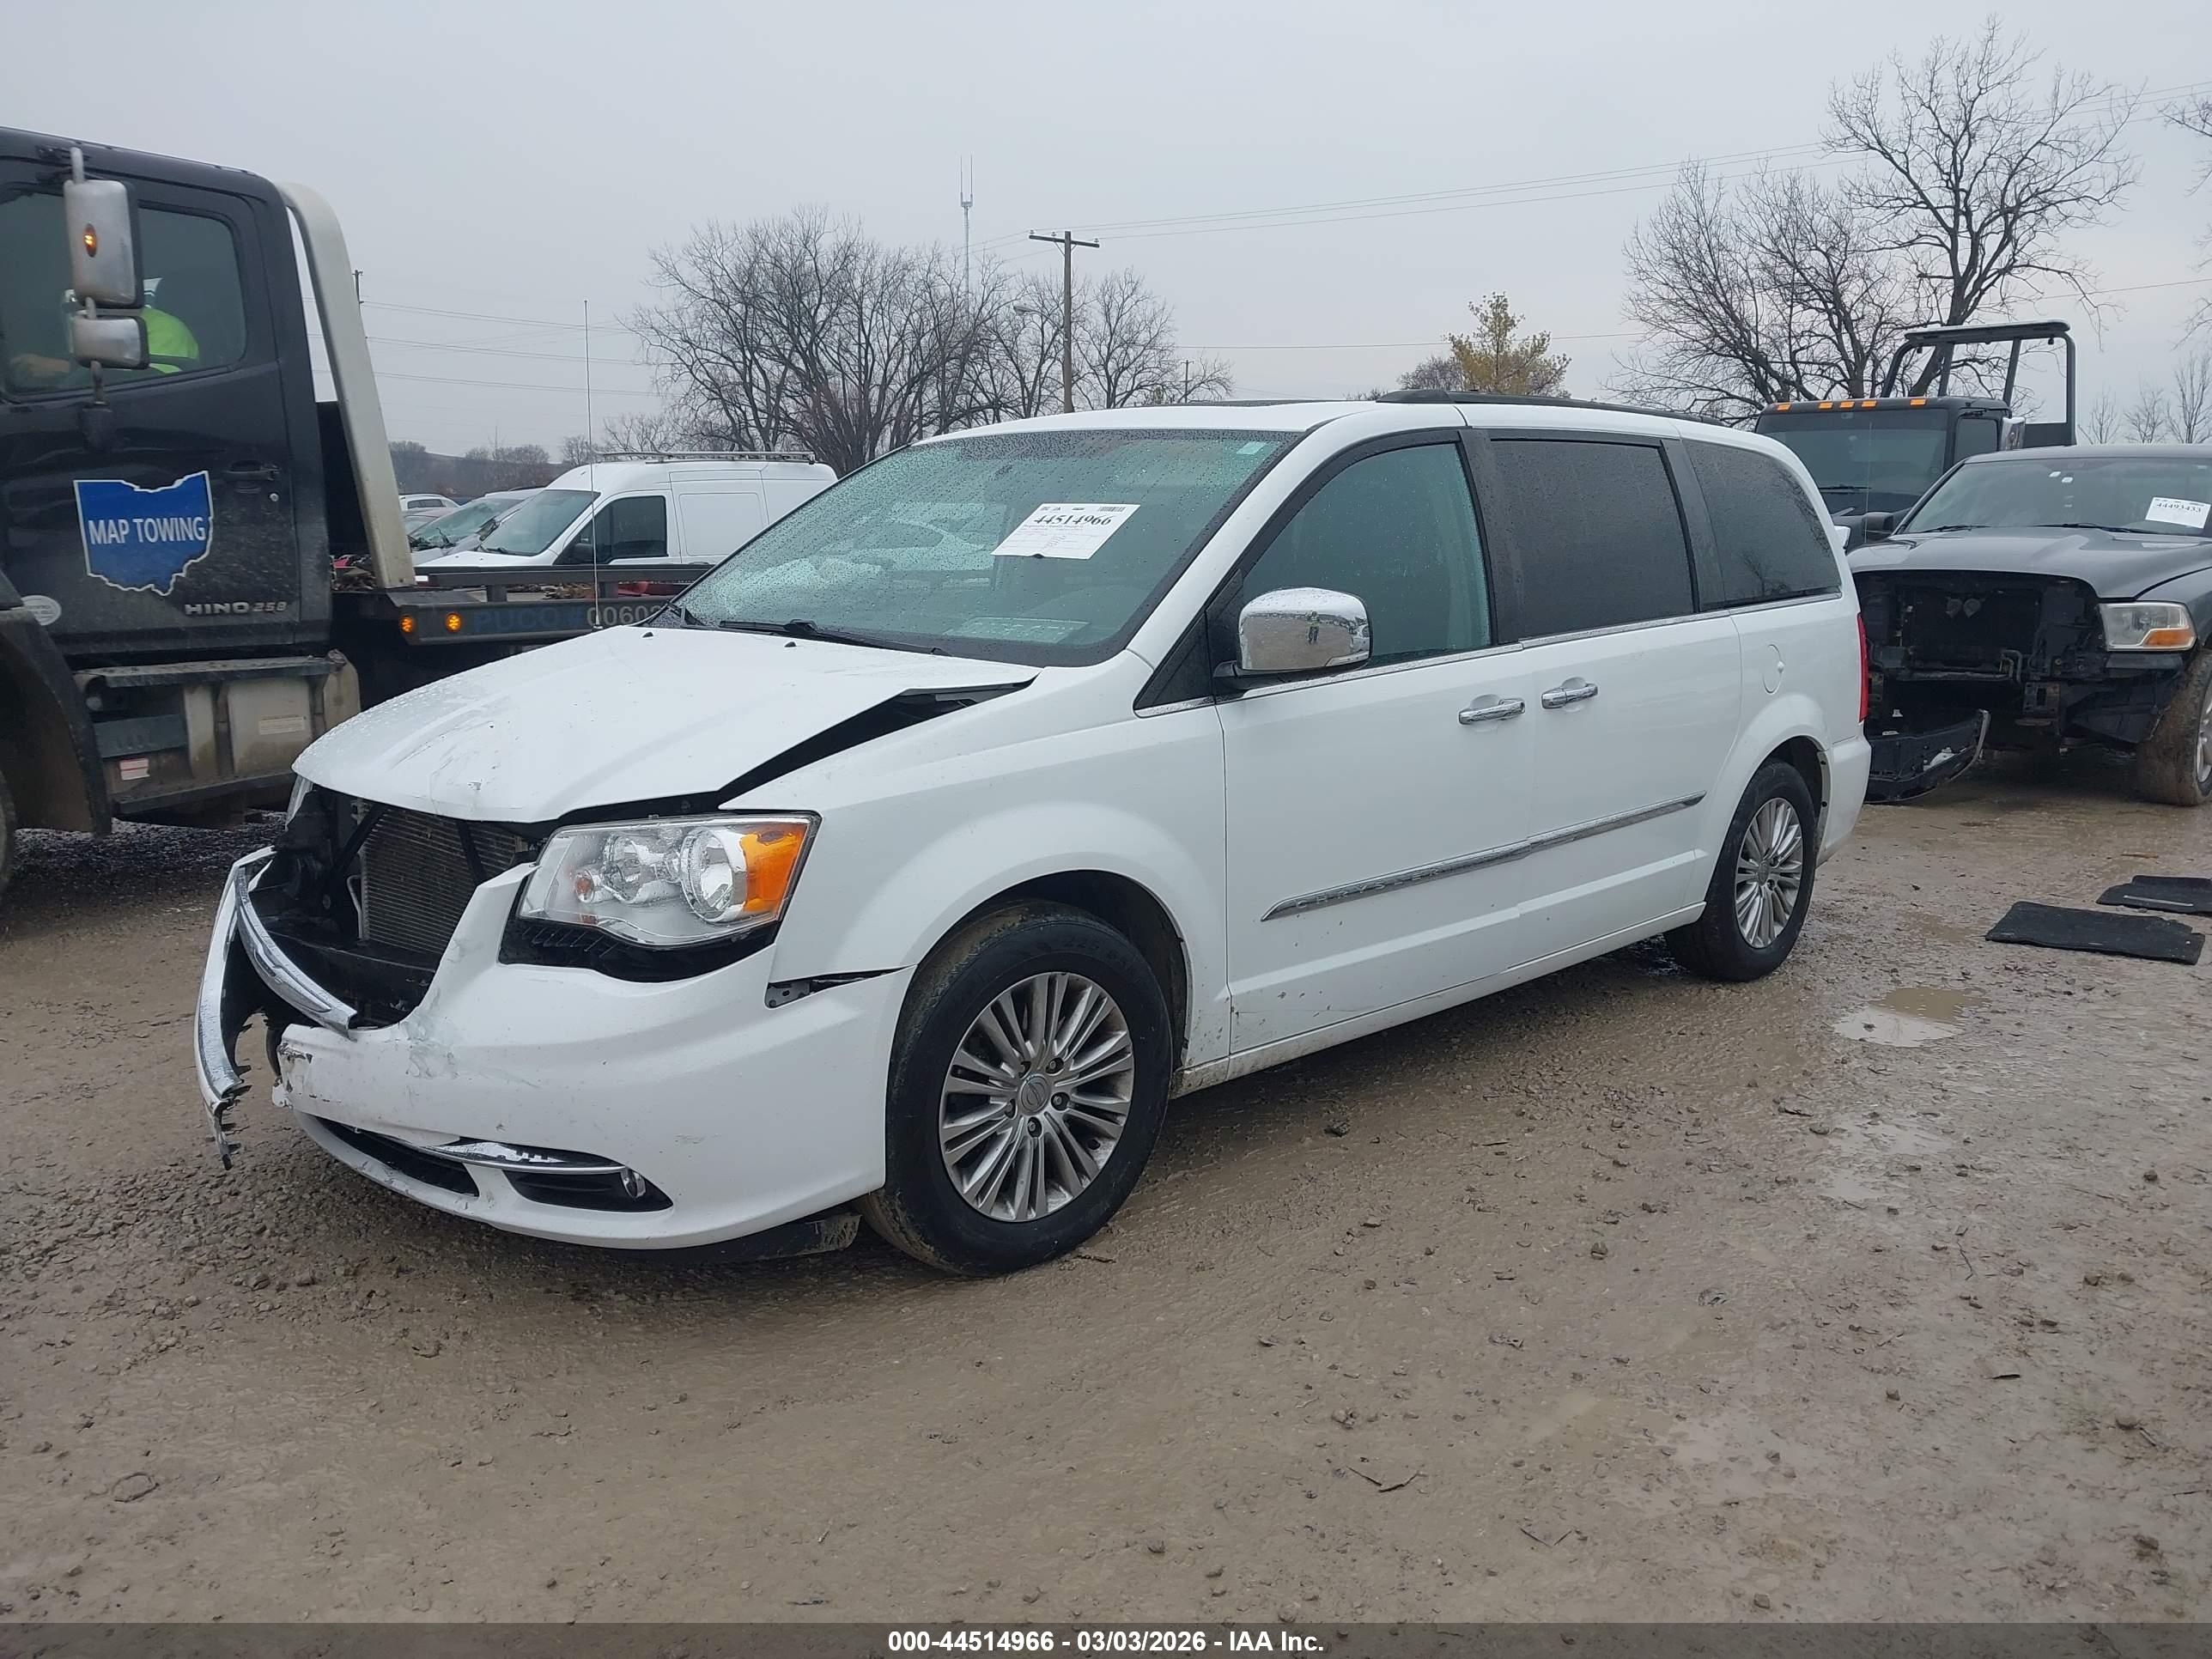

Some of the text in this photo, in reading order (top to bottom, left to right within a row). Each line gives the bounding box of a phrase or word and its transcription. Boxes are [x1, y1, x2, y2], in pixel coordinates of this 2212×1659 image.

[88, 517, 207, 545] MAP TOWING
[1034, 514, 1114, 526] 44514966
[185, 602, 287, 616] HINO 258
[475, 606, 555, 633] PUCO
[1295, 867, 1439, 909] CHRYSLER
